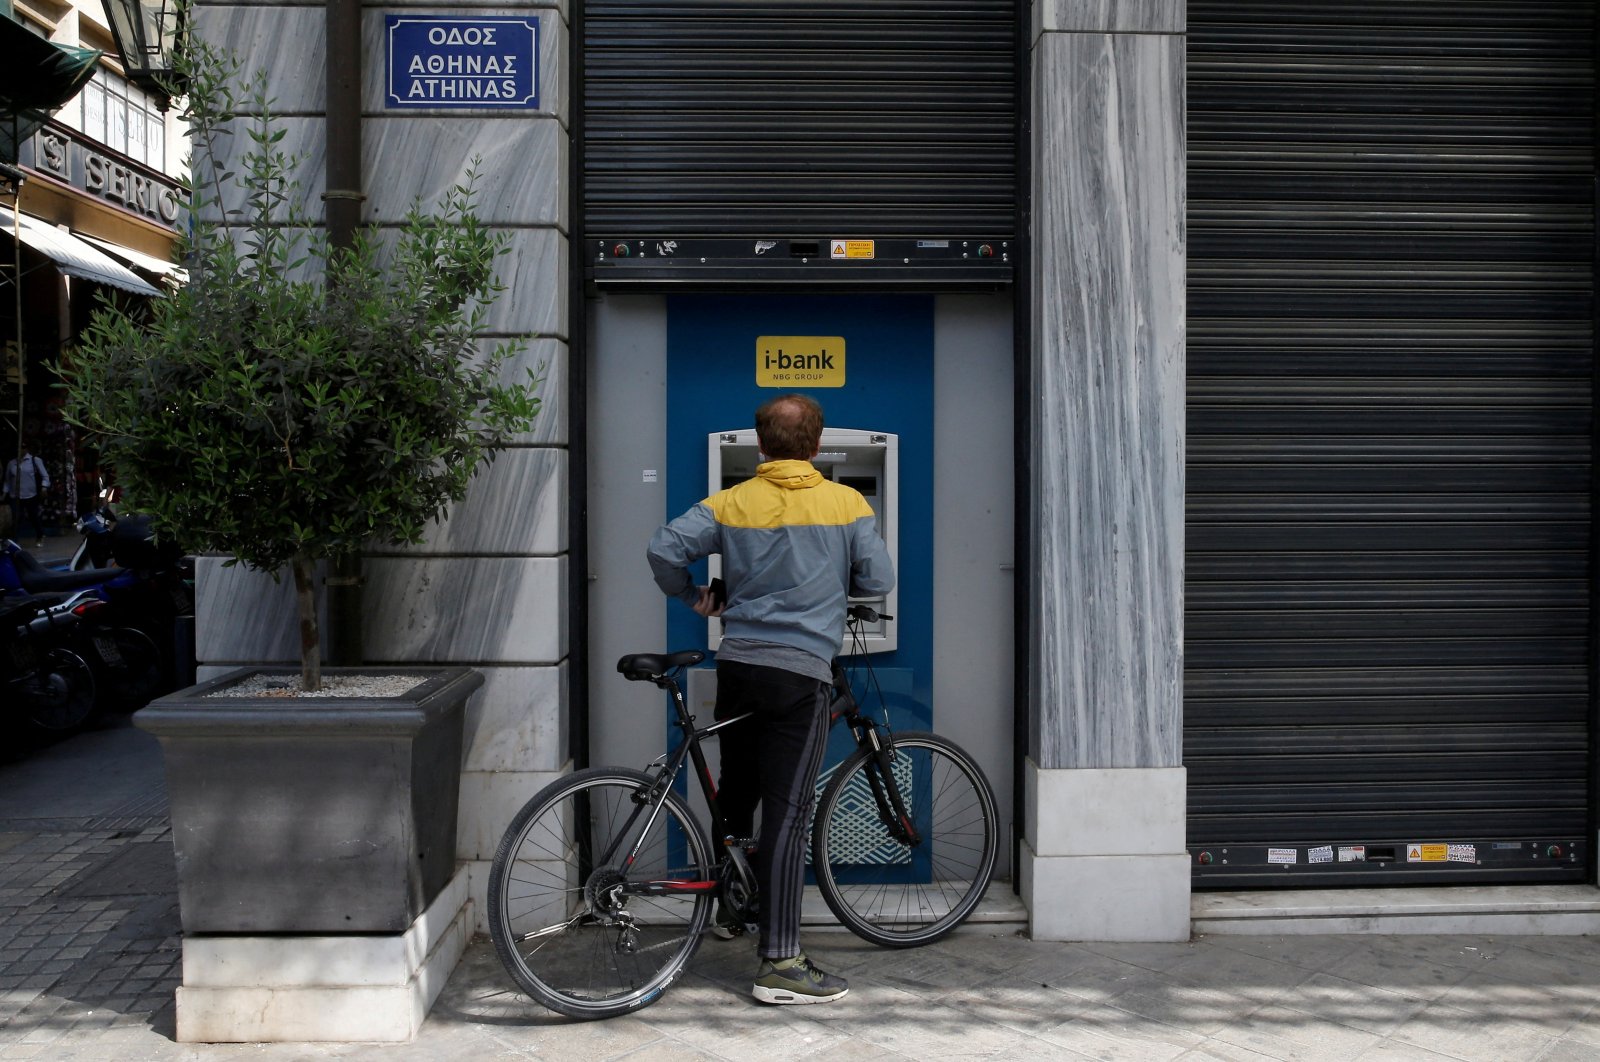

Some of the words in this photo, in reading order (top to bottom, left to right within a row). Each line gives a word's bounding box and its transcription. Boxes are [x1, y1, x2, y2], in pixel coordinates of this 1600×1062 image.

[428, 27, 497, 46] ΟΔΟΣ
[408, 54, 517, 74] ΑΘΗΝΑΣ
[408, 79, 517, 99] ATHINAS
[118, 106, 159, 152] SERO
[85, 153, 180, 222] SERIO
[765, 349, 834, 369] i-bank
